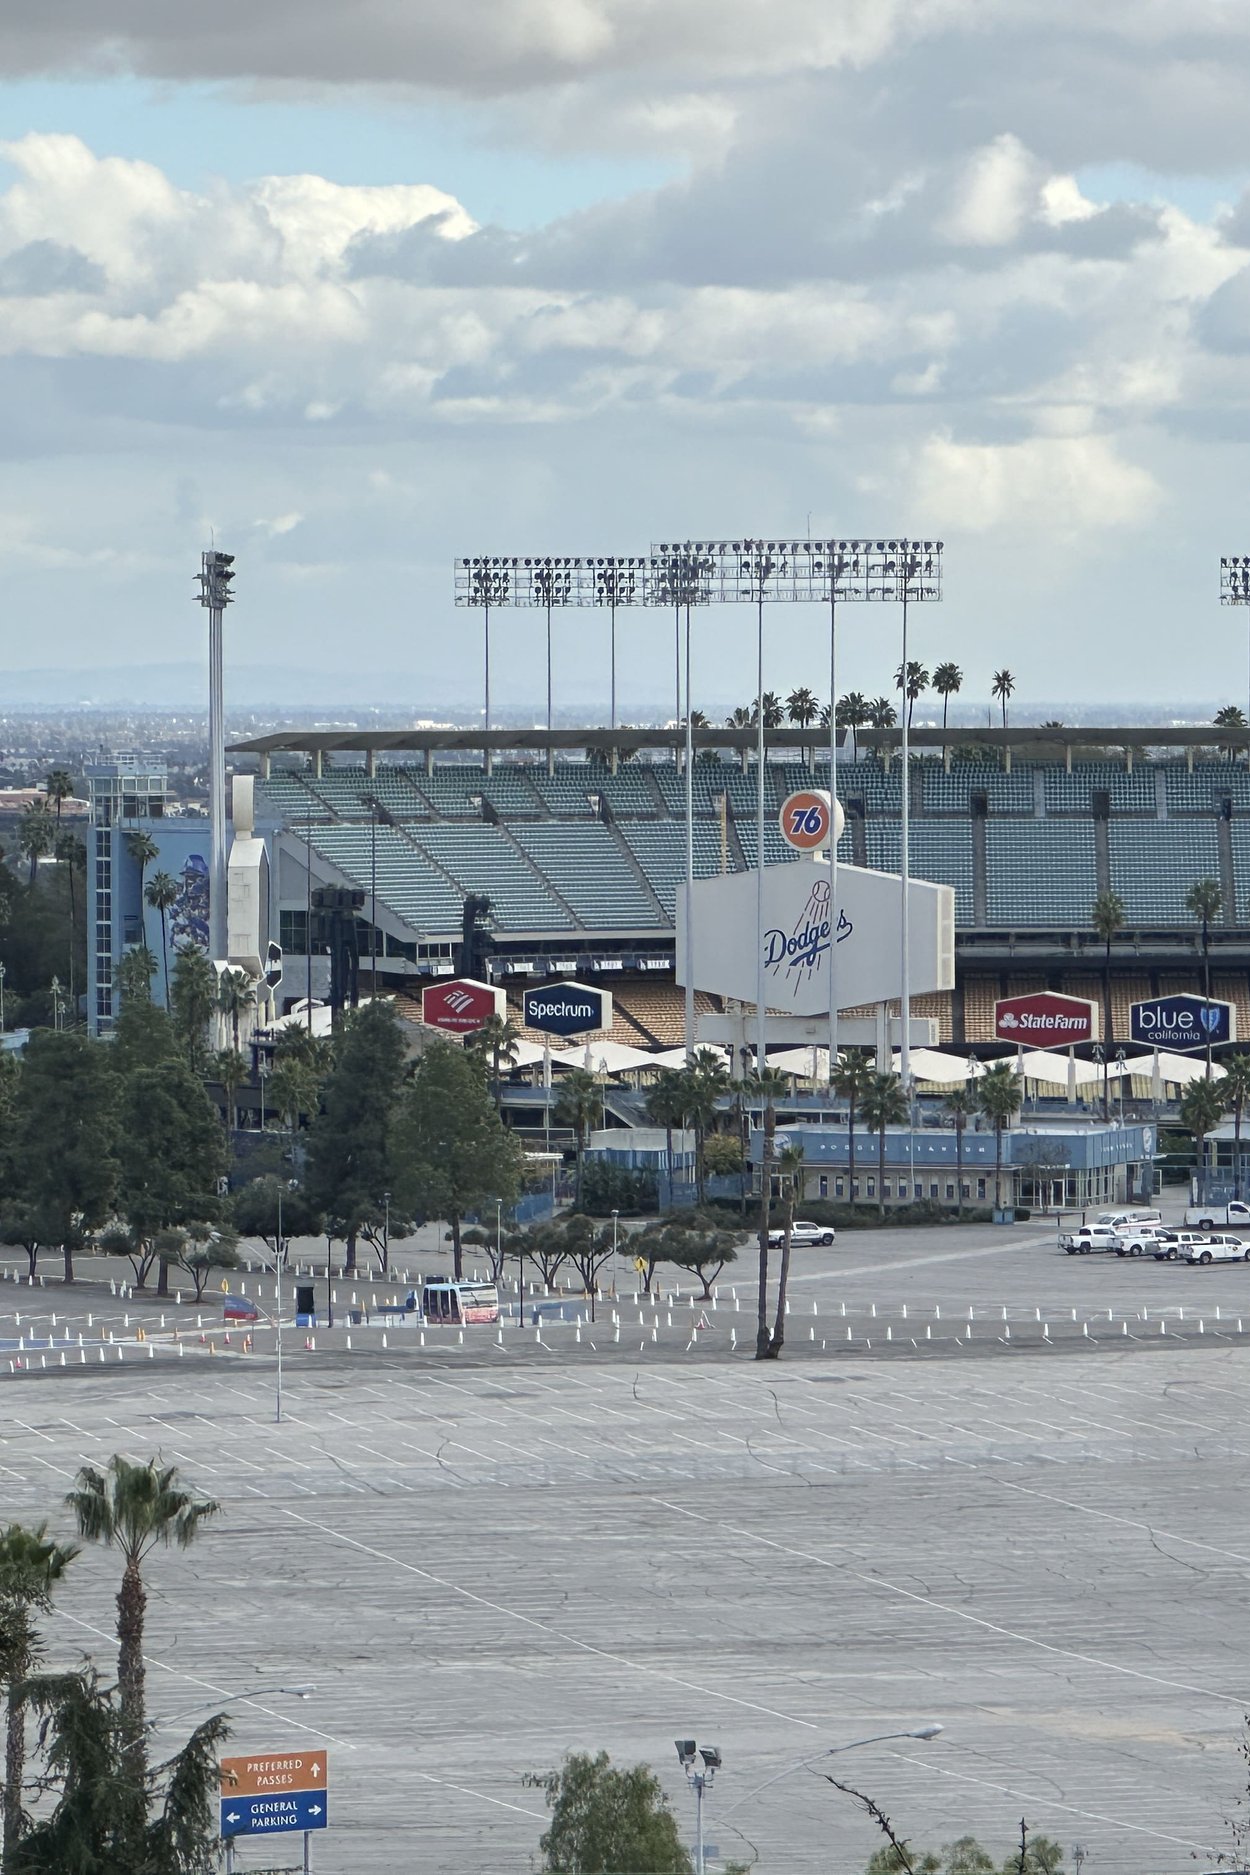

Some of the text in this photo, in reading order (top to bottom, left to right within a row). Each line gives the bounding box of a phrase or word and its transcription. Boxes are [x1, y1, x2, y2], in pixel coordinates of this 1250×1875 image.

[789, 805, 824, 836] 76
[763, 909, 853, 969] Dodges
[529, 1001, 592, 1019] Spectrum
[1139, 1006, 1194, 1029] blue
[1147, 1030, 1201, 1041] california
[246, 1759, 303, 1773] PREFERRED
[256, 1774, 293, 1786] PASSES
[250, 1801, 298, 1814] GENERAL
[251, 1815, 298, 1827] PARKING
